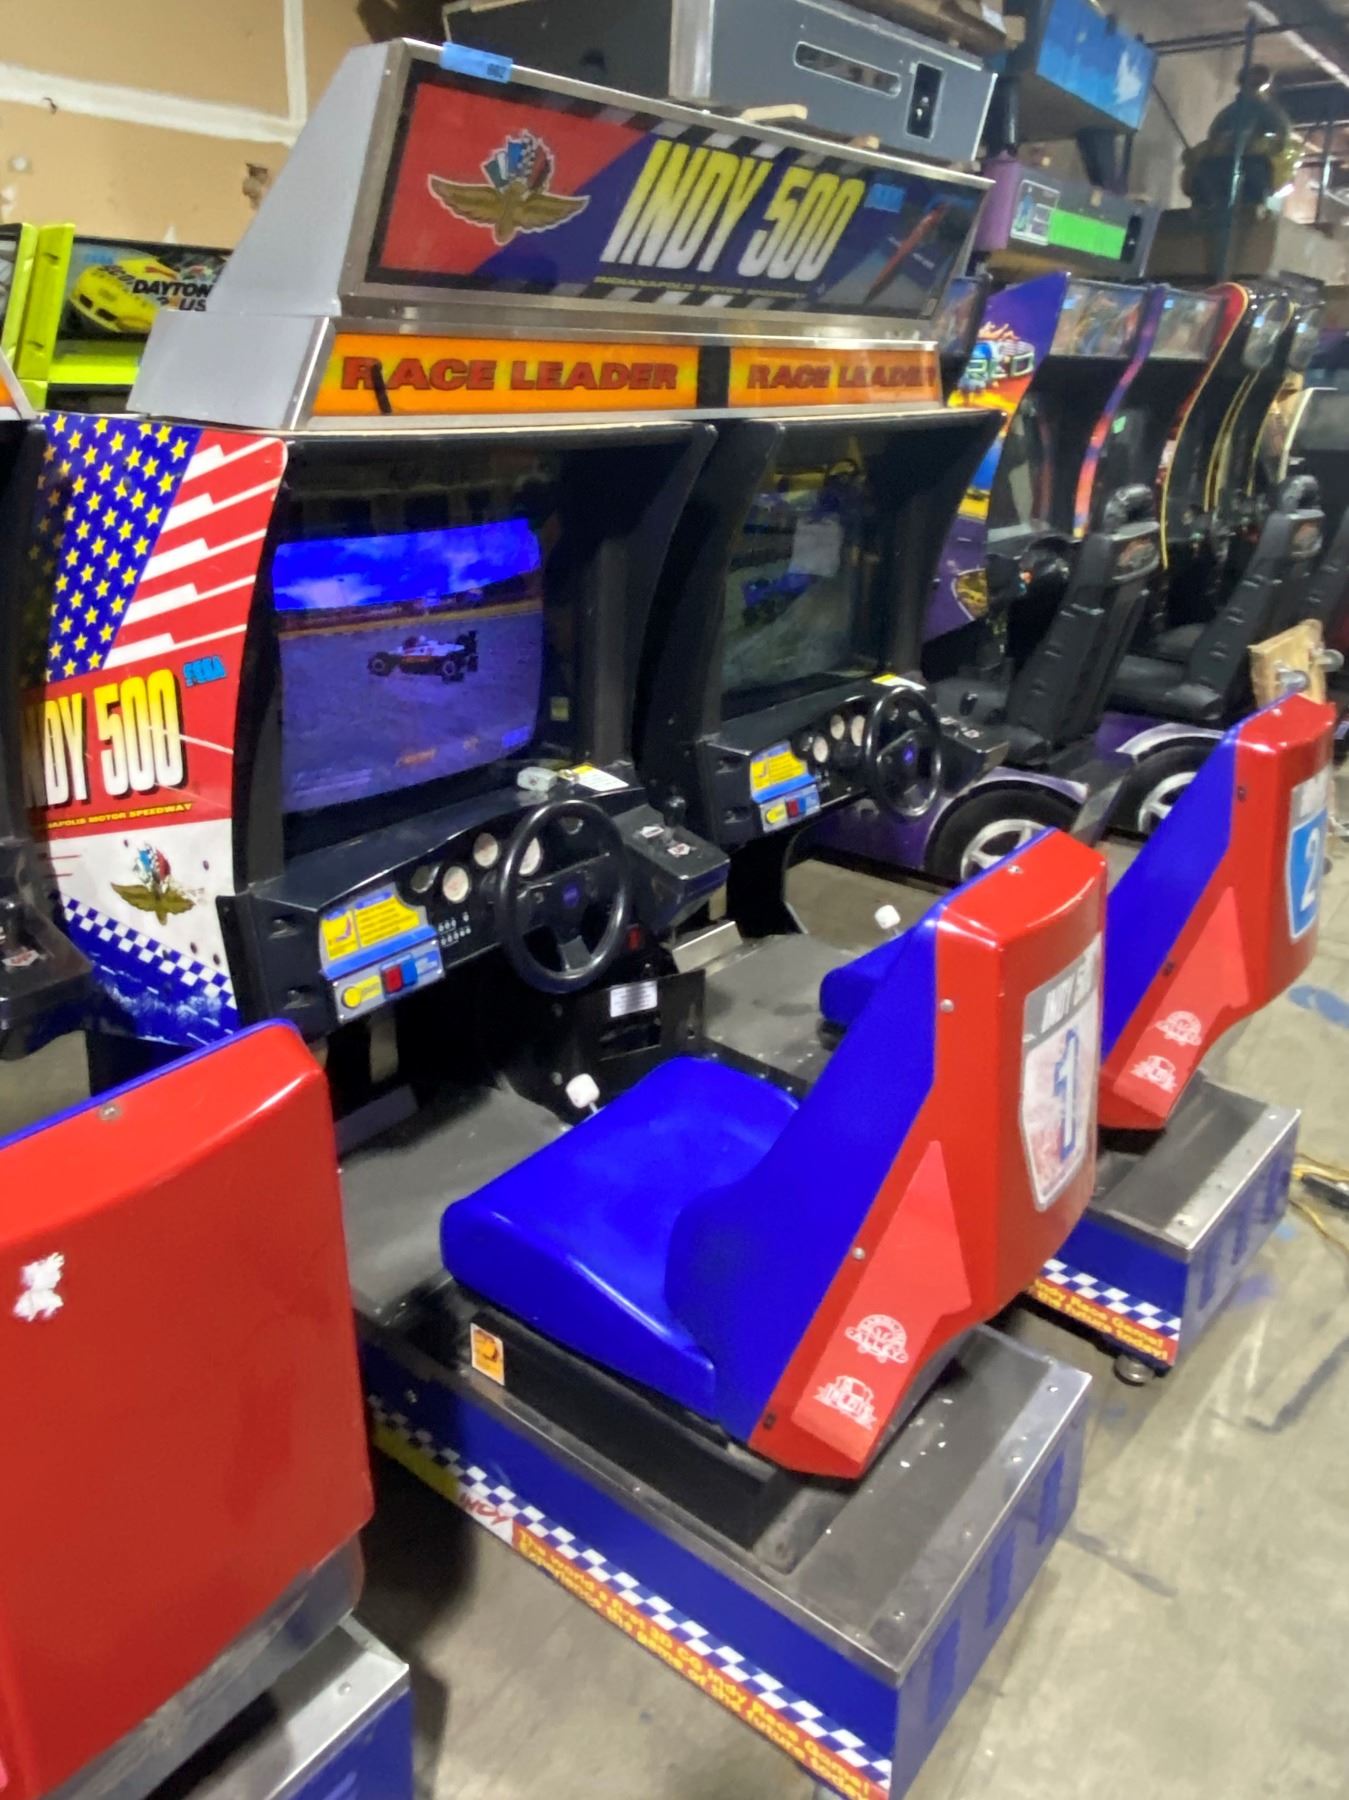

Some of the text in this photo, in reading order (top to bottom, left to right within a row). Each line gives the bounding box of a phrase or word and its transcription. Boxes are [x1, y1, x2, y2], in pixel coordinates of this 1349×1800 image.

[600, 139, 866, 282] INDY 500
[341, 357, 678, 391] RACE LEADER
[747, 364, 831, 390] RACE
[94, 668, 183, 796] 500
[129, 803, 192, 818] SPEEDWAY
[1301, 826, 1322, 912] 2
[1053, 1027, 1079, 1162] 1
[707, 1667, 748, 1706] Indy
[751, 1700, 799, 1743] Race
[804, 1739, 870, 1799] Game!
